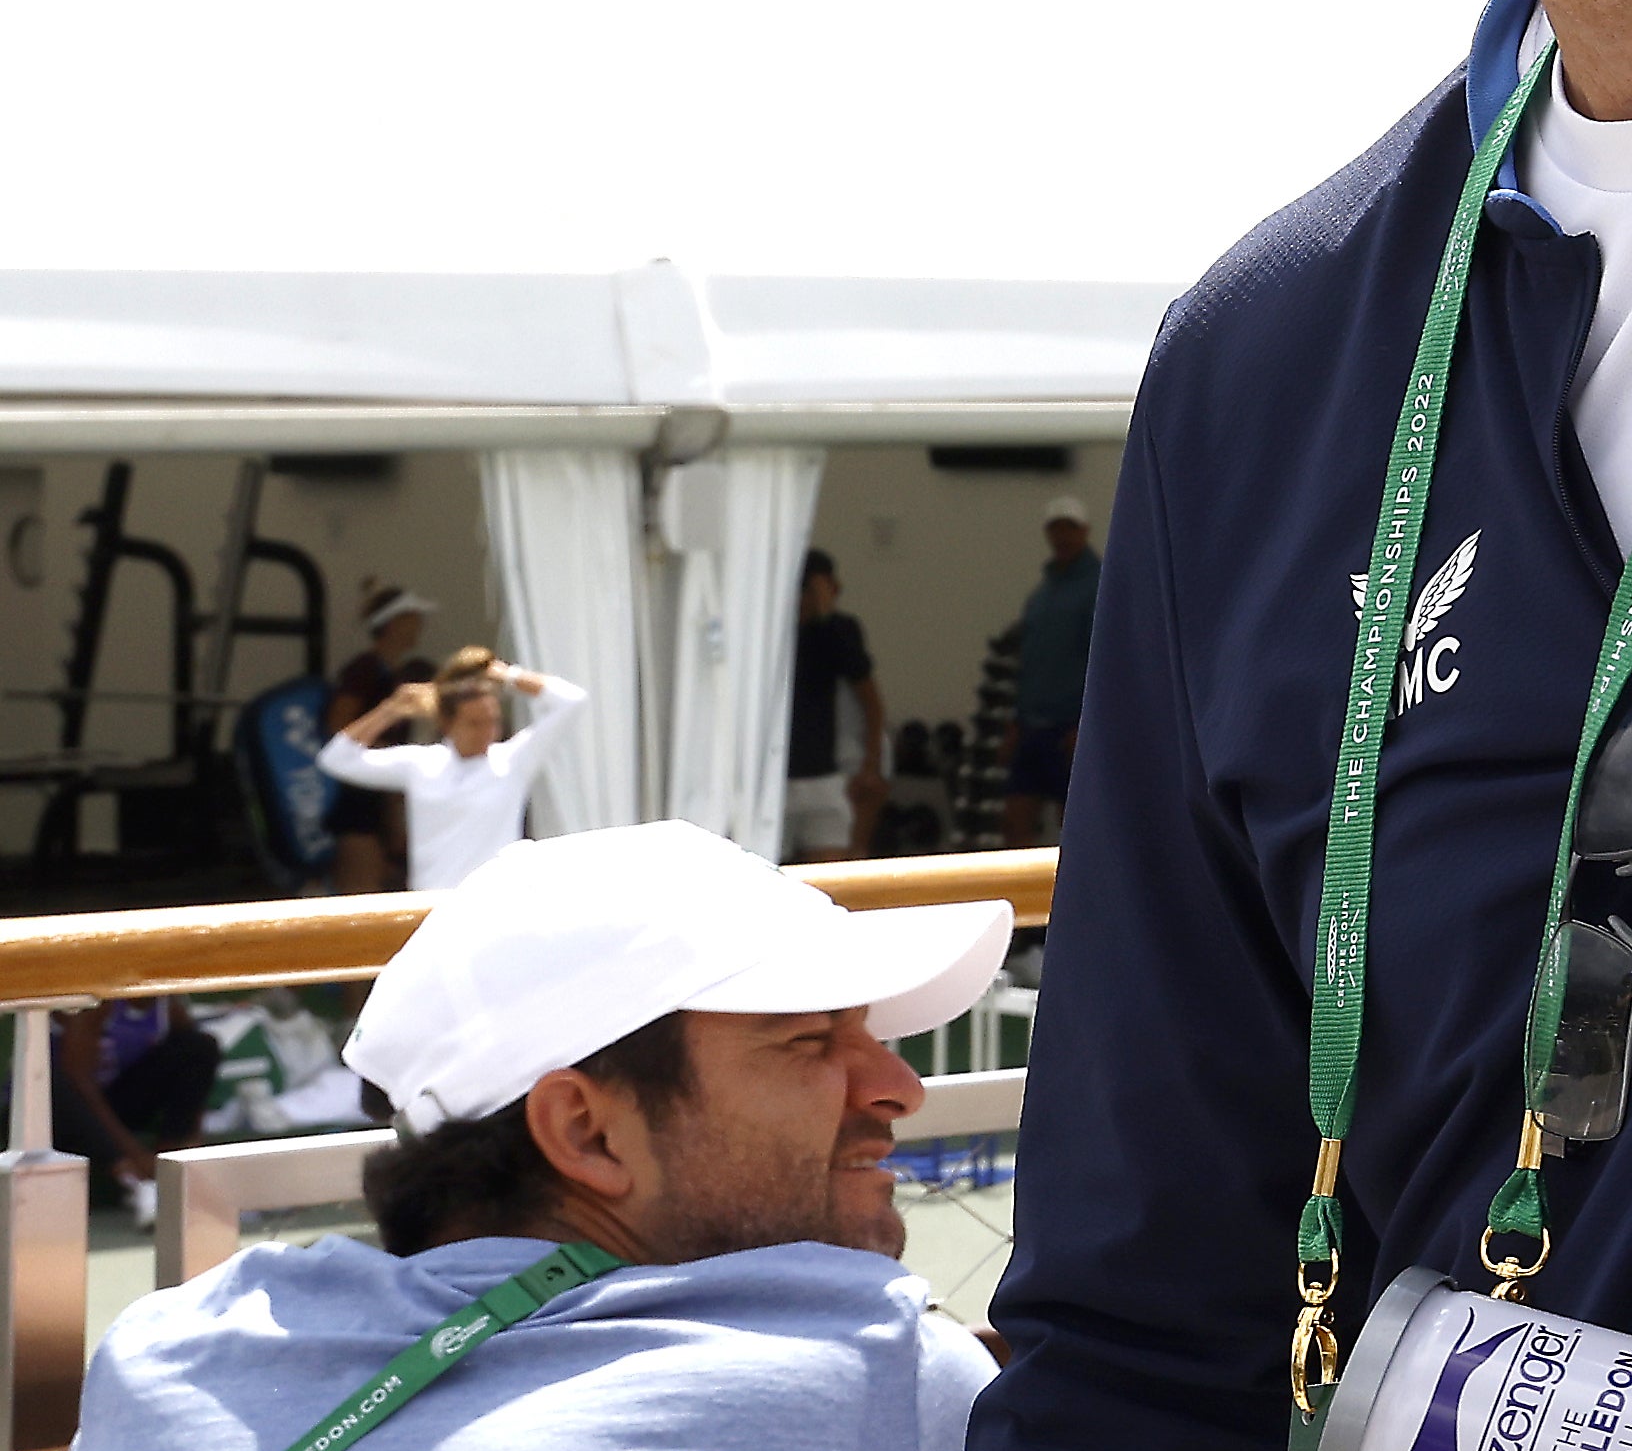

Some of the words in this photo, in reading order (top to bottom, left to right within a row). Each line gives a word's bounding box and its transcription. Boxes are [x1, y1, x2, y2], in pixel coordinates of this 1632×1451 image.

[1408, 372, 1434, 451] 2022
[1352, 463, 1418, 746] CHAMPIONSHIPS
[1343, 757, 1365, 823] THE
[1340, 890, 1352, 942] COURT
[1336, 945, 1347, 1009] CENTRE
